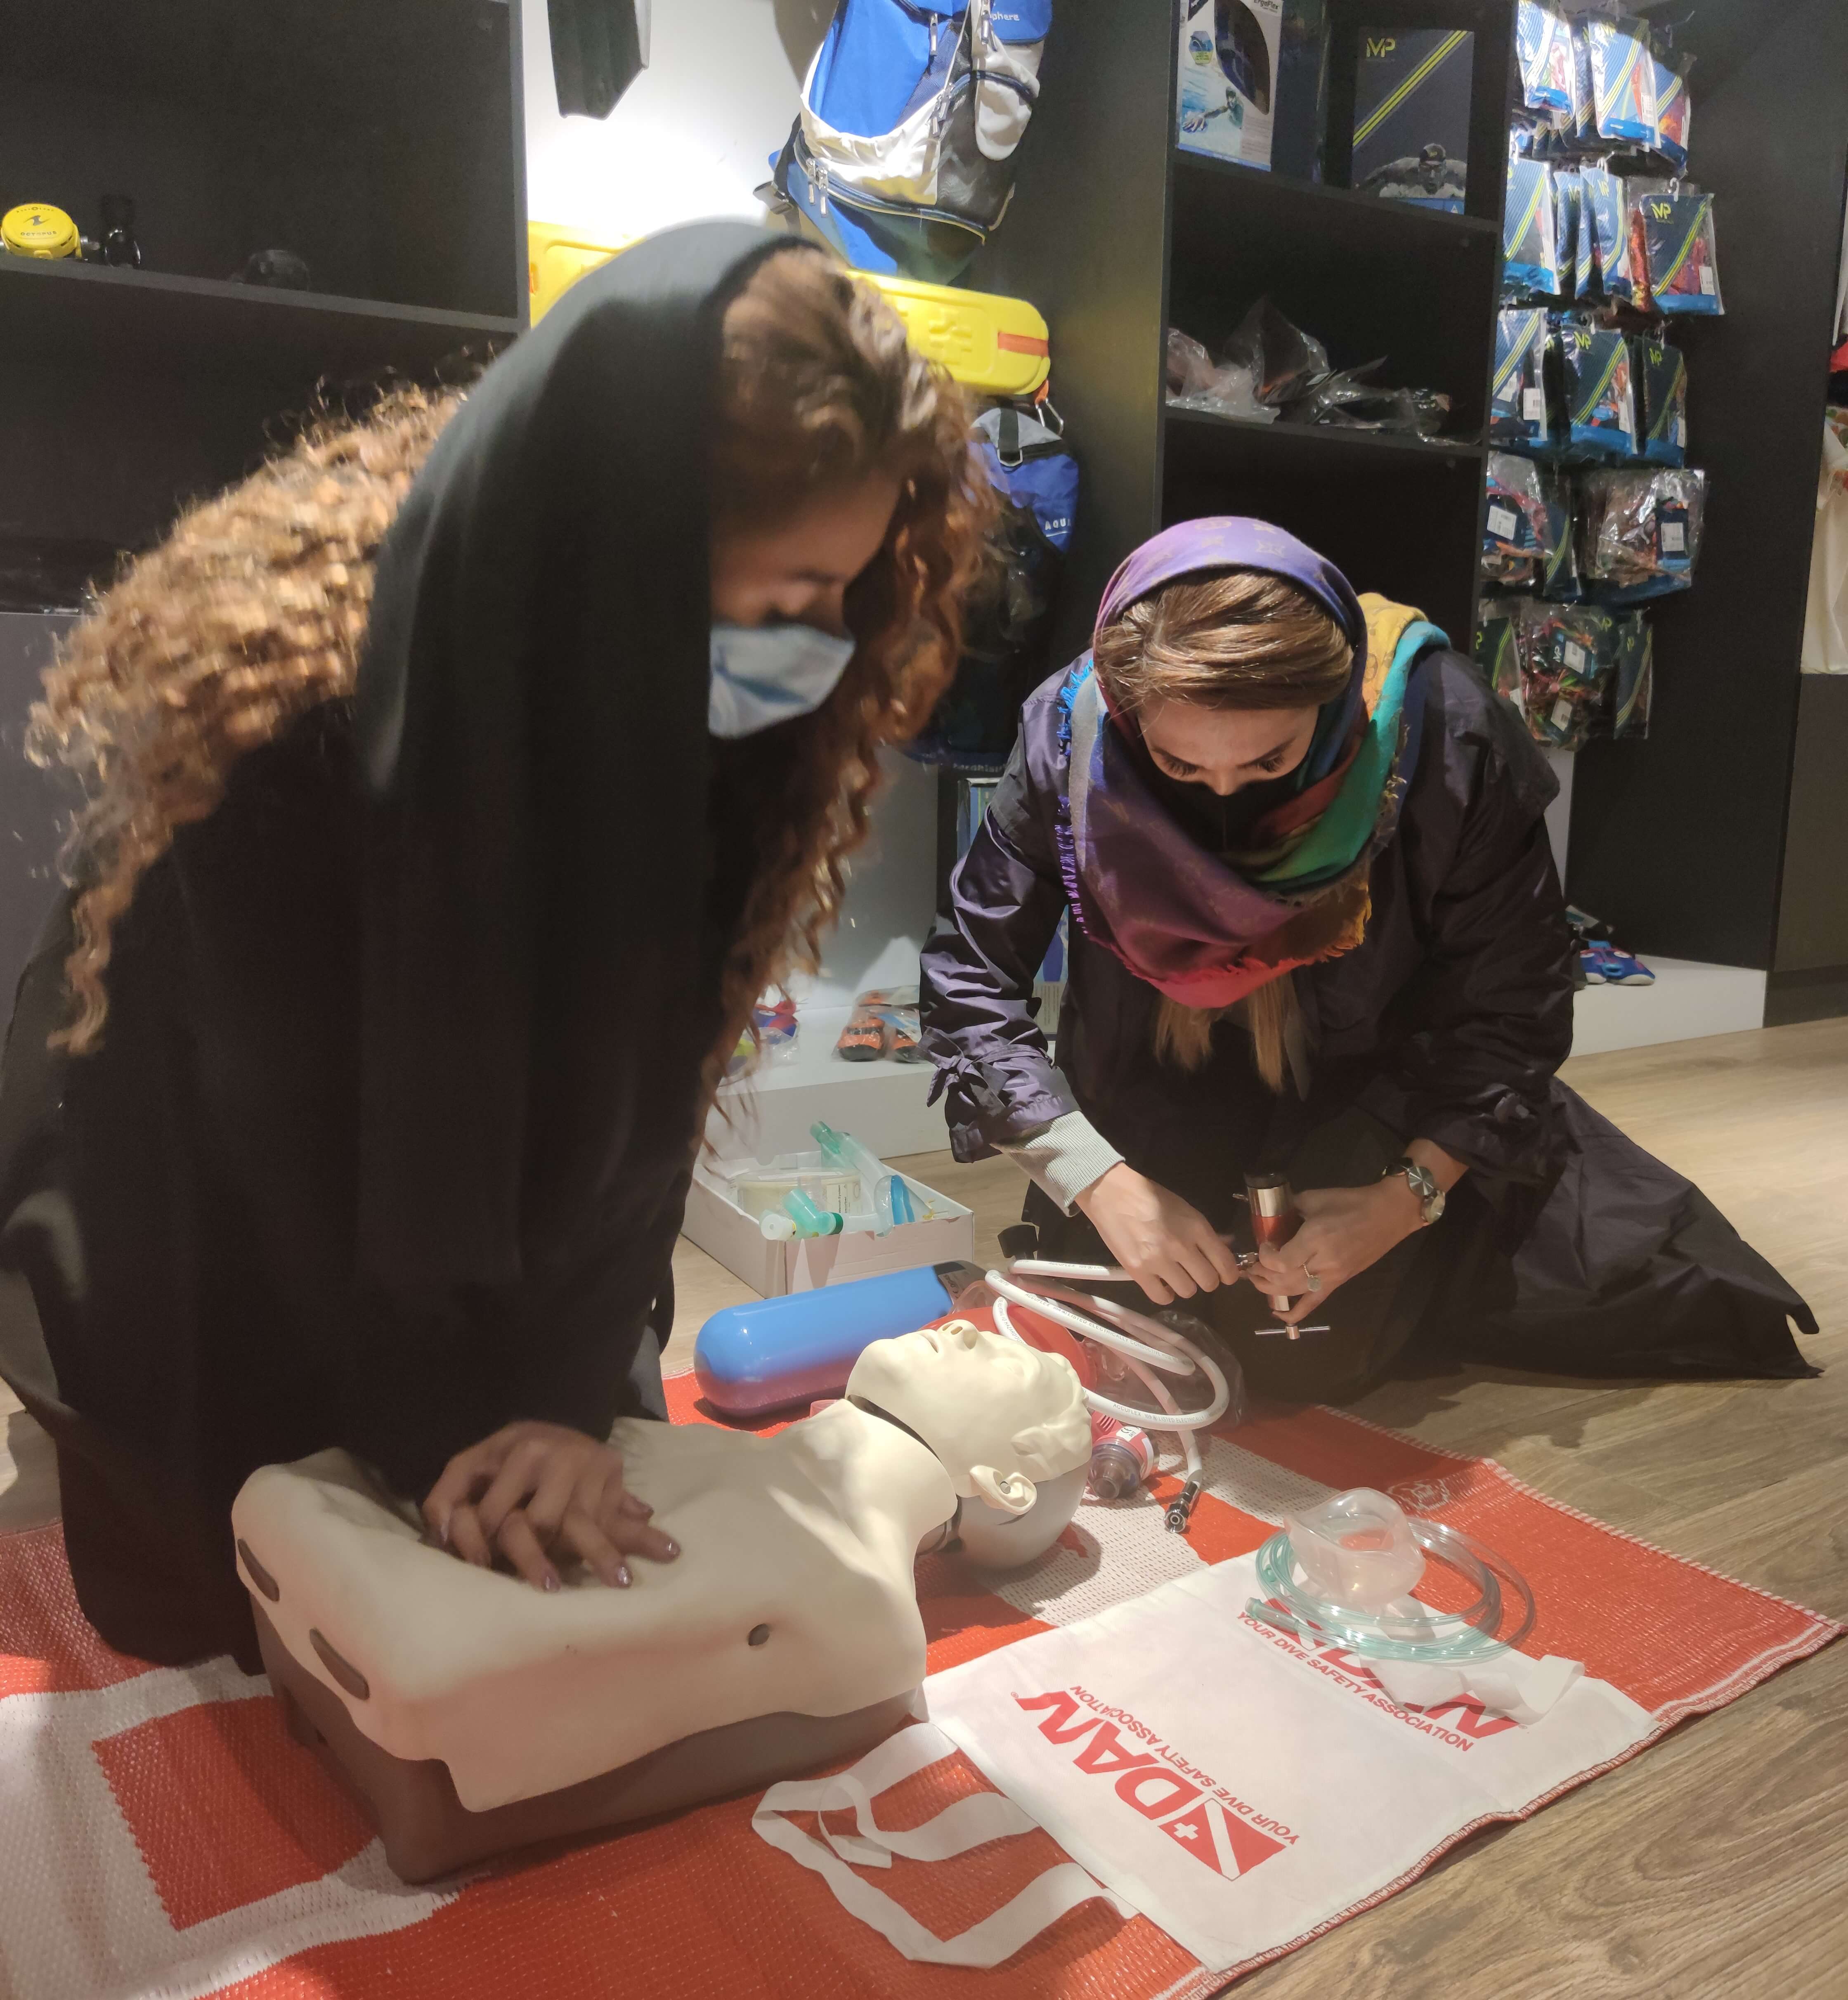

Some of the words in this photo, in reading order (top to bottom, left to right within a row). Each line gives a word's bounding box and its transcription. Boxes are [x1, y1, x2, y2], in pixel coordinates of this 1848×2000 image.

[990, 12, 1020, 21] phere
[1366, 38, 1395, 57] MP
[1651, 202, 1671, 219] MP
[1025, 1293, 1050, 1307] ACCUFLEX
[1068, 1313, 1087, 1324] LISTED
[1089, 1323, 1128, 1342] ELECTRICALLY
[1113, 1404, 1141, 1416] ACCUFLEX
[1176, 1415, 1204, 1423] ELECTRICALLY
[1237, 1612, 1276, 1638] YOUR
[1273, 1638, 1310, 1660] DIVE
[1307, 1659, 1368, 1693] SAFETY
[1361, 1693, 1474, 1752] ASSOCIATION
[1070, 1685, 1162, 1746] ASSOCIATION
[1015, 1690, 1204, 1820] DAN
[1155, 1745, 1217, 1787] SAFETY
[1212, 1787, 1255, 1816] DIVE
[1251, 1813, 1300, 1845] YOUR
